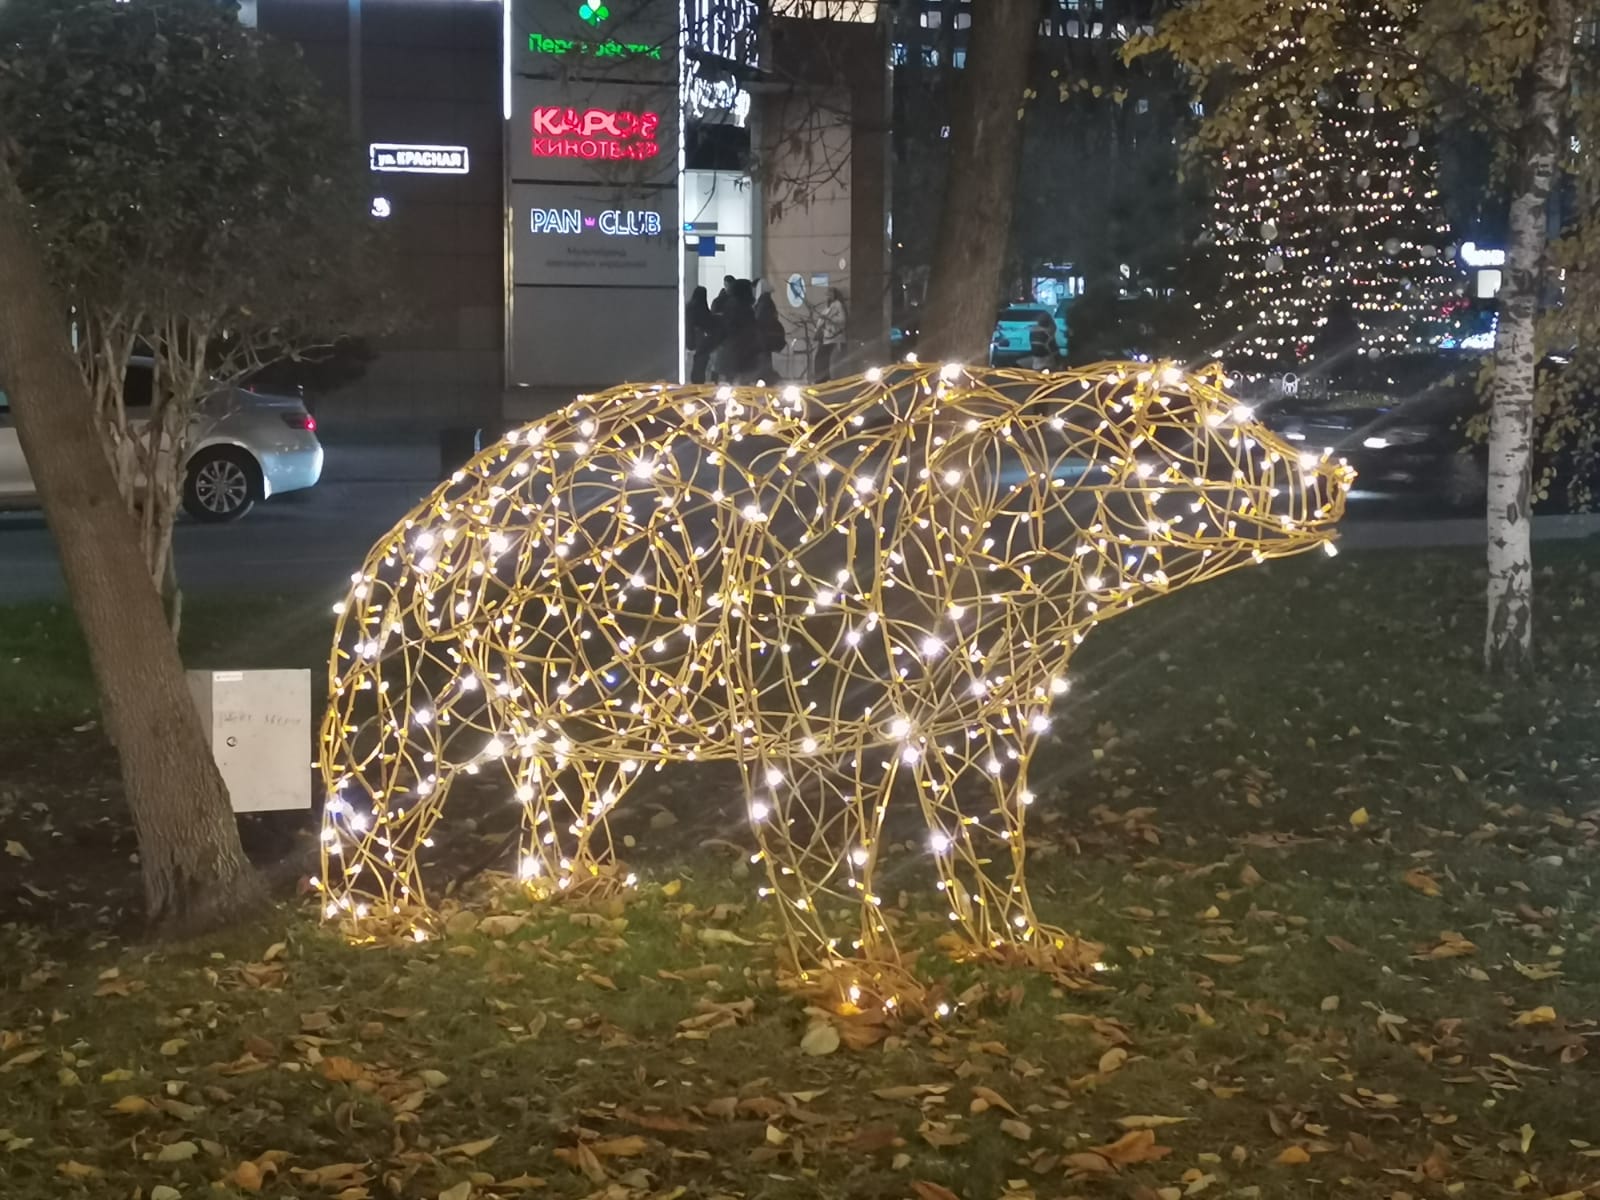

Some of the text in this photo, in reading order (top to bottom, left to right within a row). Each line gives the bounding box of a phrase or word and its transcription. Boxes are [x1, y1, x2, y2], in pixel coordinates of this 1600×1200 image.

[396, 151, 462, 167] КРАСНАЯ
[530, 208, 661, 235] PAN CLUB
